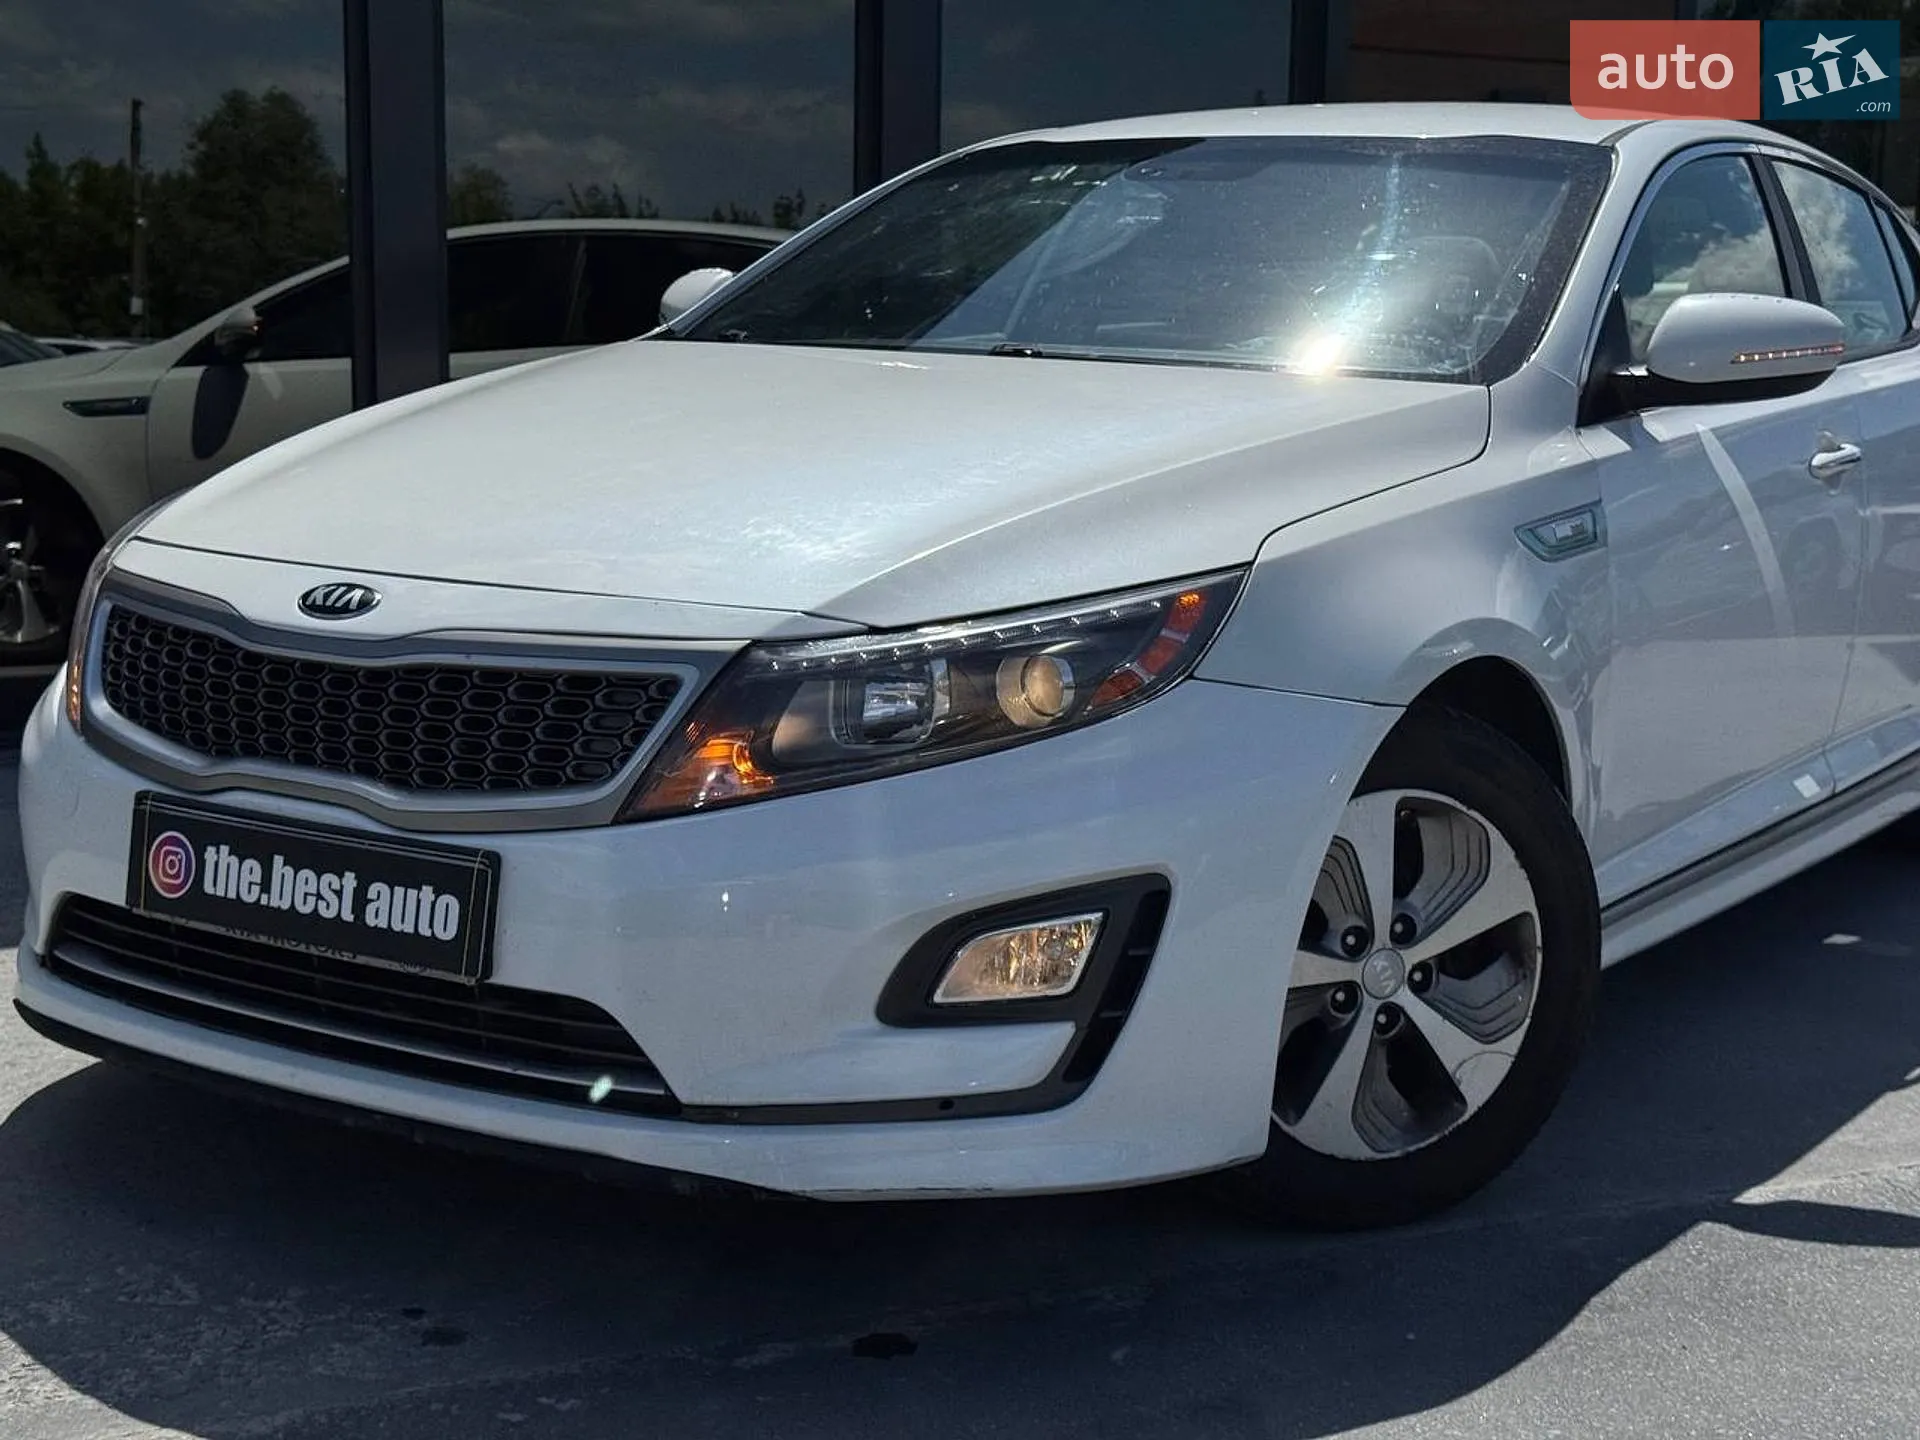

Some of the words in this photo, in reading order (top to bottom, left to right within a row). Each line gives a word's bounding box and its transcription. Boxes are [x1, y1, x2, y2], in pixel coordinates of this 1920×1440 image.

[305, 585, 366, 610] KIA
[203, 844, 358, 923] the.best
[364, 880, 461, 942] auto
